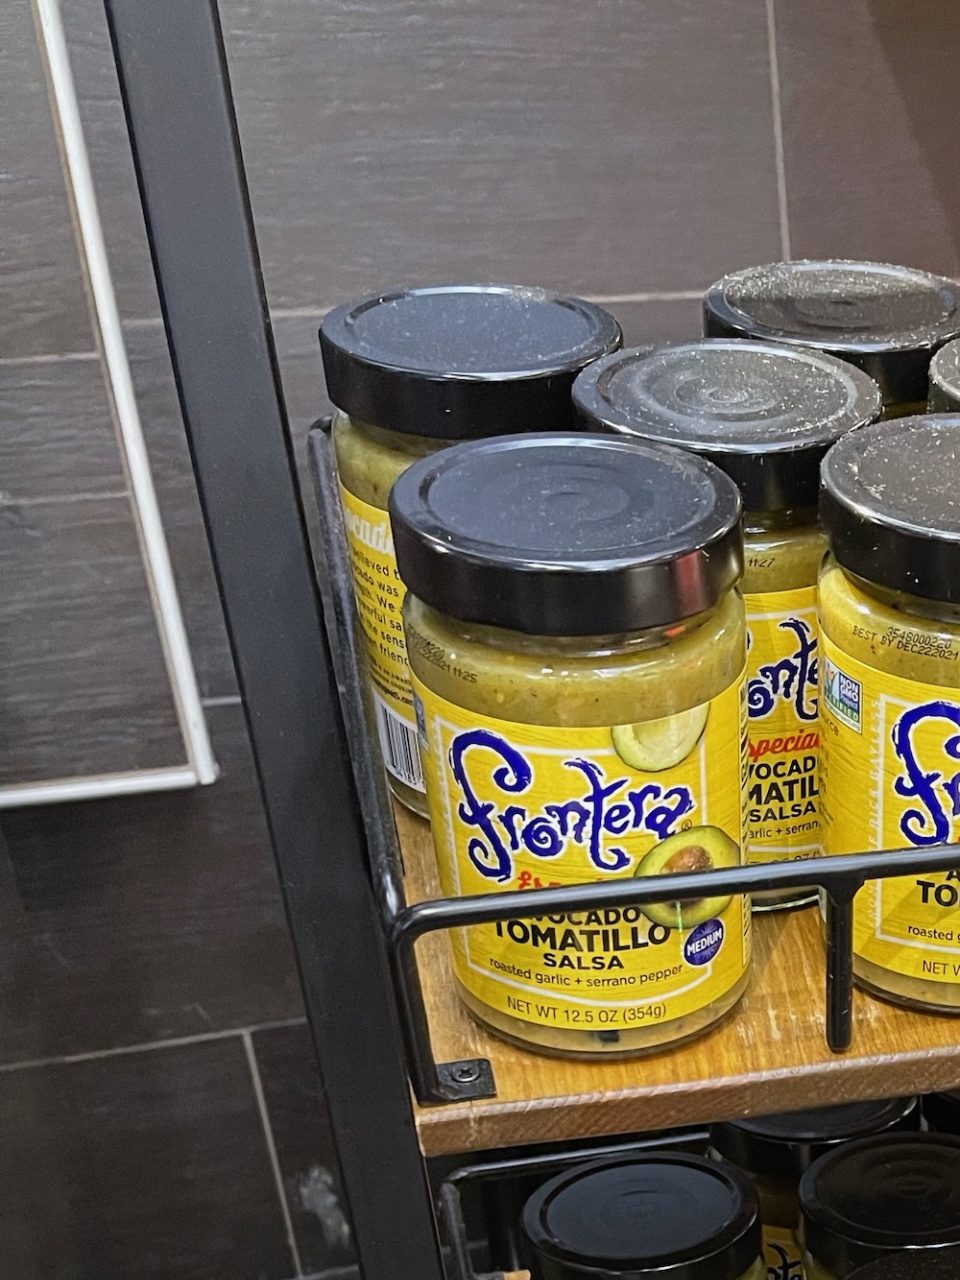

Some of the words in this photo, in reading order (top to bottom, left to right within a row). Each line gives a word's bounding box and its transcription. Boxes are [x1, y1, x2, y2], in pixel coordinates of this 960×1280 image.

[377, 580, 400, 597] was
[376, 596, 396, 613] We
[852, 625, 878, 643] BEST
[880, 635, 895, 648] BY
[840, 675, 860, 693] NON
[496, 917, 672, 953] TOMATILLO
[686, 926, 724, 958] MEDIUM
[908, 925, 954, 942] roasted
[543, 952, 625, 971] SALSA
[922, 959, 949, 976] NET
[489, 956, 533, 980] roasted
[535, 972, 571, 987] garlic
[586, 976, 637, 988] serrano
[640, 962, 684, 986] pepper
[507, 995, 533, 1016] NET
[536, 1006, 559, 1021] WT
[563, 1009, 594, 1024] 12.5
[598, 1009, 619, 1023] OZ
[622, 1001, 667, 1023] (354g)
